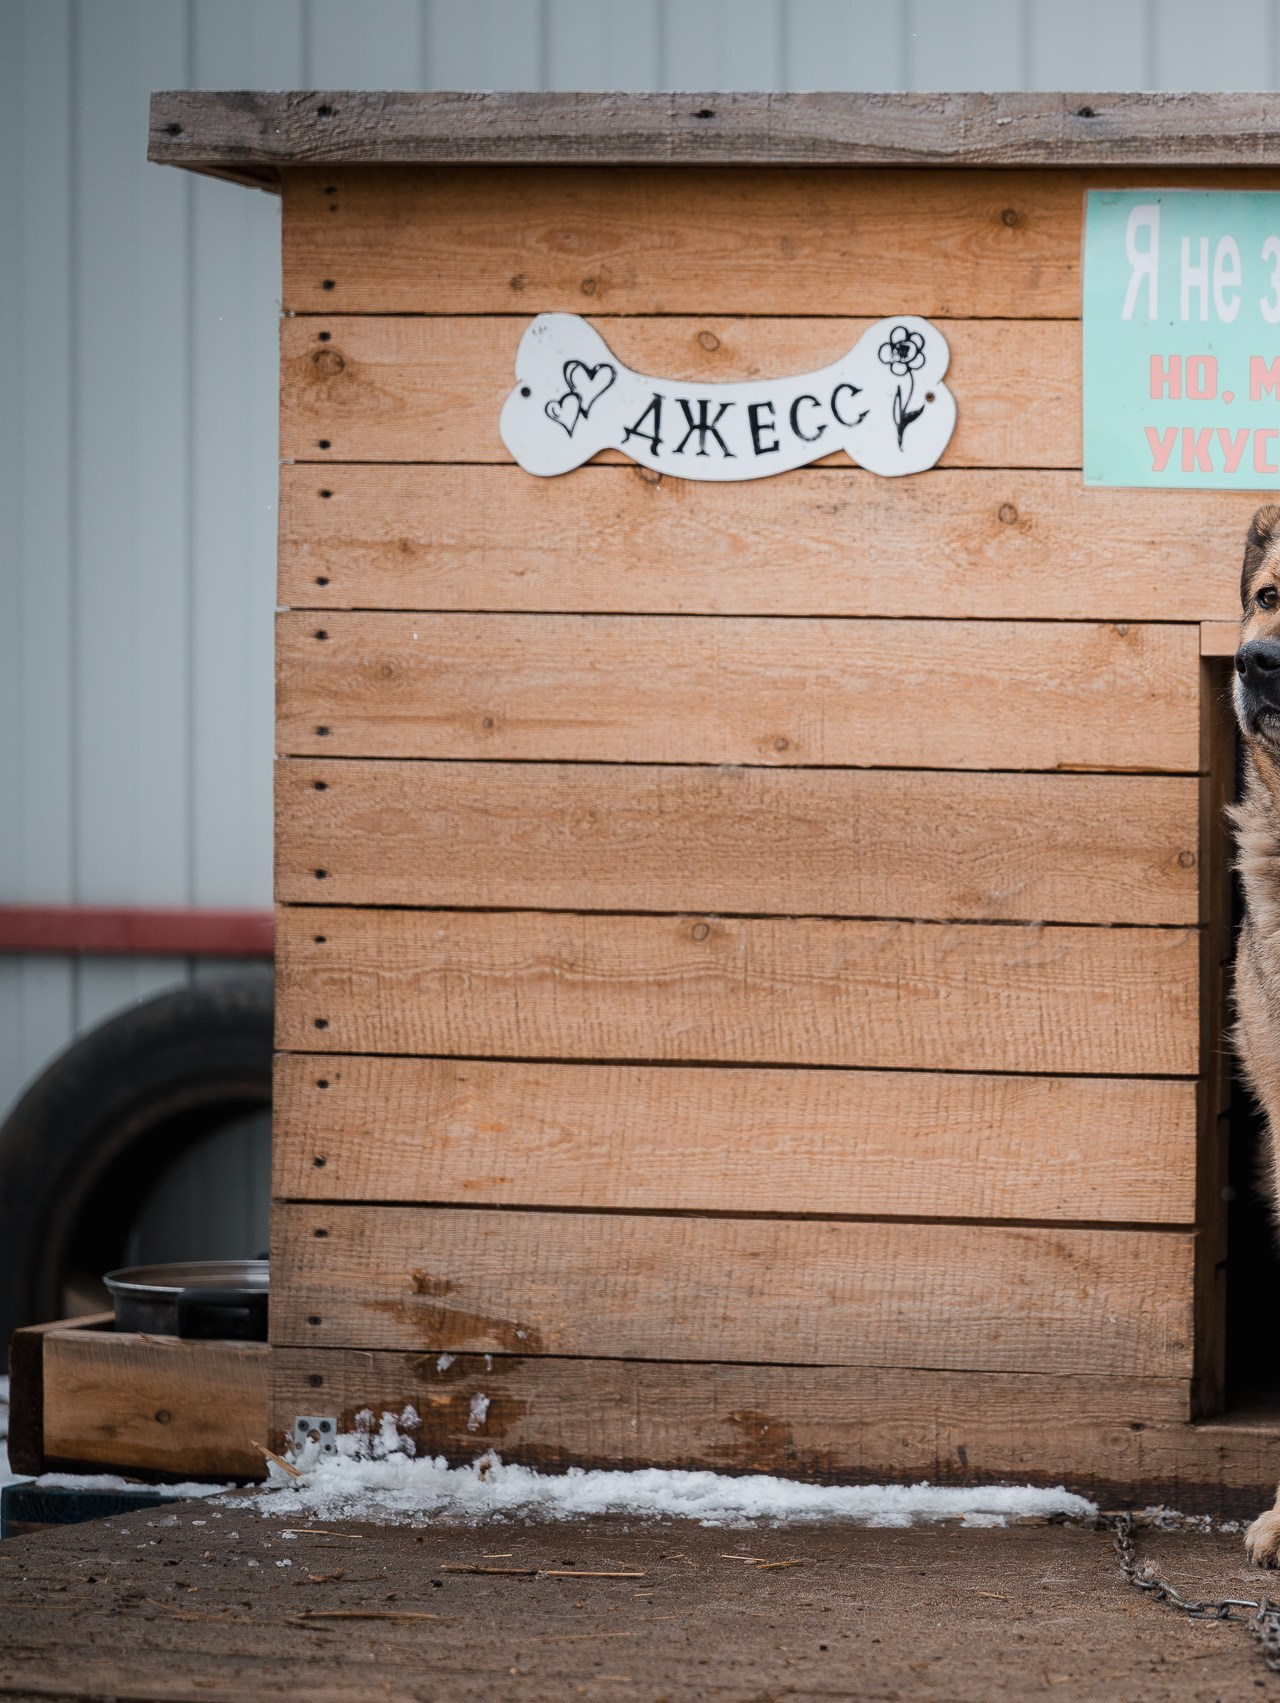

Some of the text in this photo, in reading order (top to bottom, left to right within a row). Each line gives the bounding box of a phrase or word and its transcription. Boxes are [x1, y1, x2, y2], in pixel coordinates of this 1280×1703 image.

[1120, 204, 1161, 321] Я
[1180, 235, 1242, 324] не
[1149, 354, 1235, 404] НО,
[620, 383, 870, 457] ДЖЕСС
